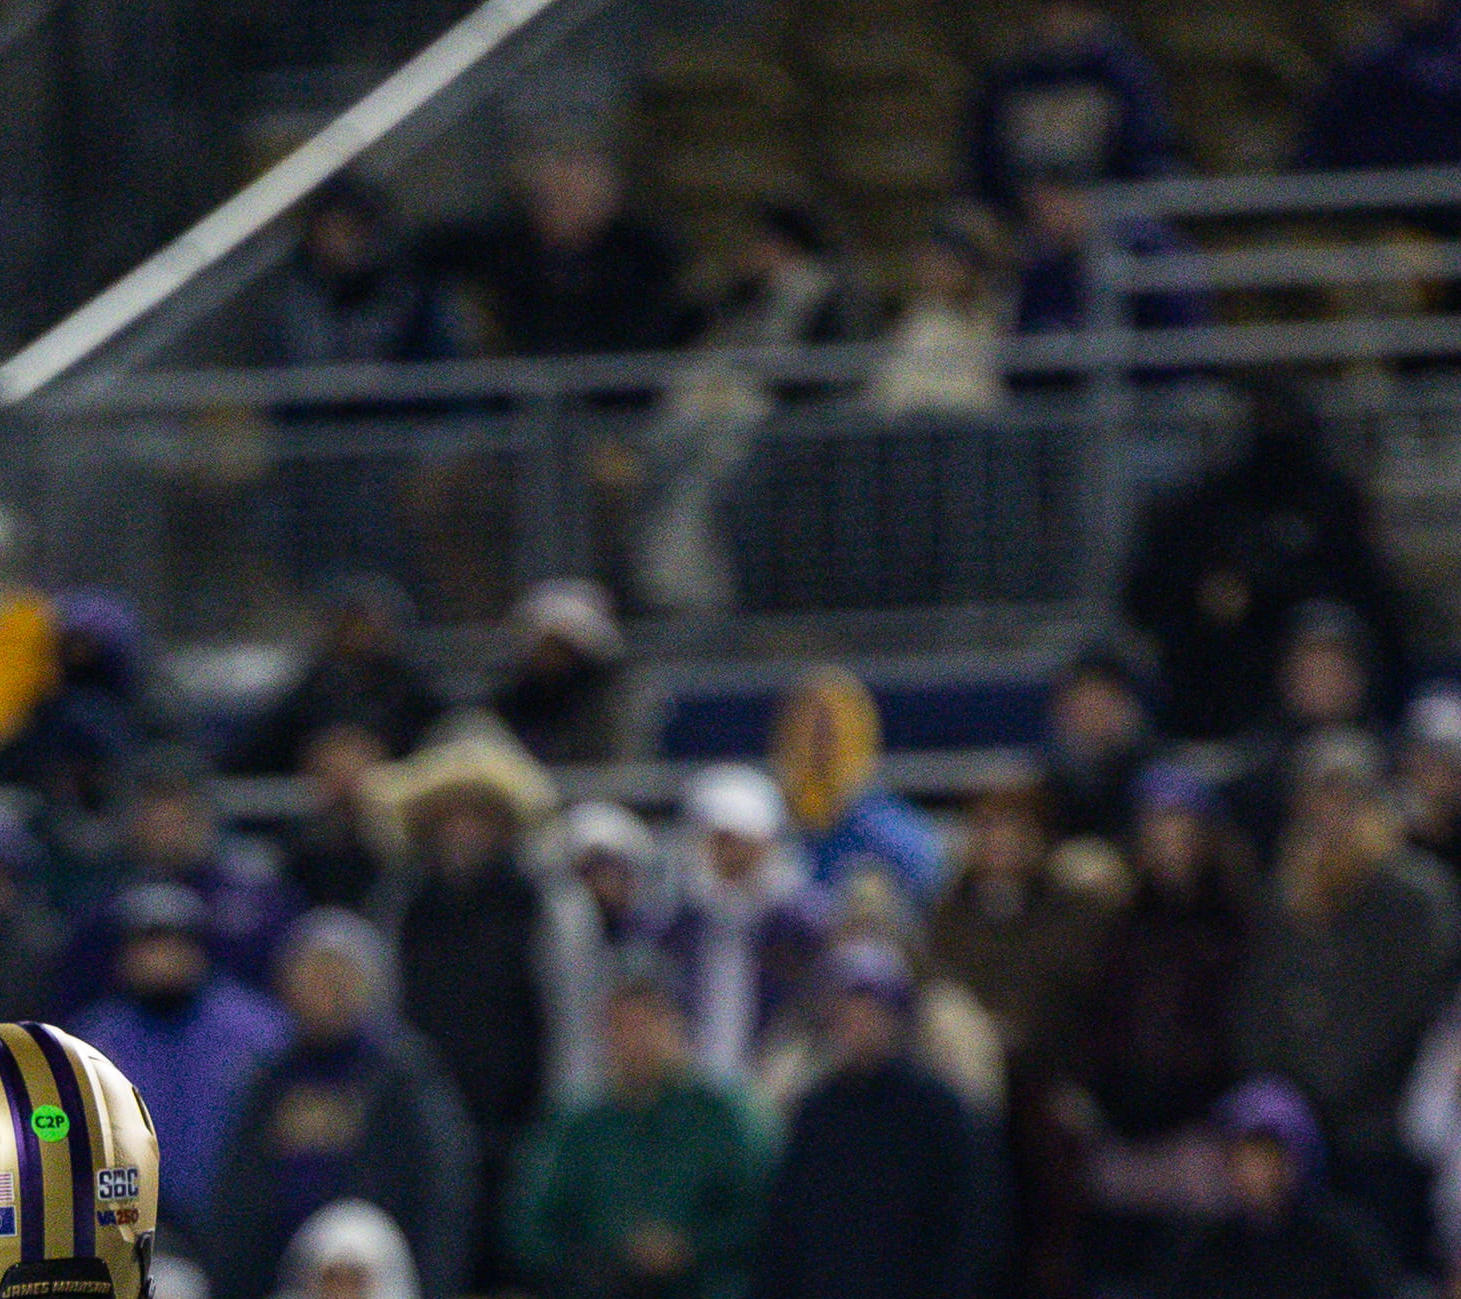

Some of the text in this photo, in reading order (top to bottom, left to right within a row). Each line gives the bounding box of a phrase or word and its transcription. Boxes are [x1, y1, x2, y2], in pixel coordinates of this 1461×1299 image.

[34, 1114, 66, 1130] C2P
[99, 1168, 140, 1200] SBC
[2, 1280, 50, 1299] JAMES
